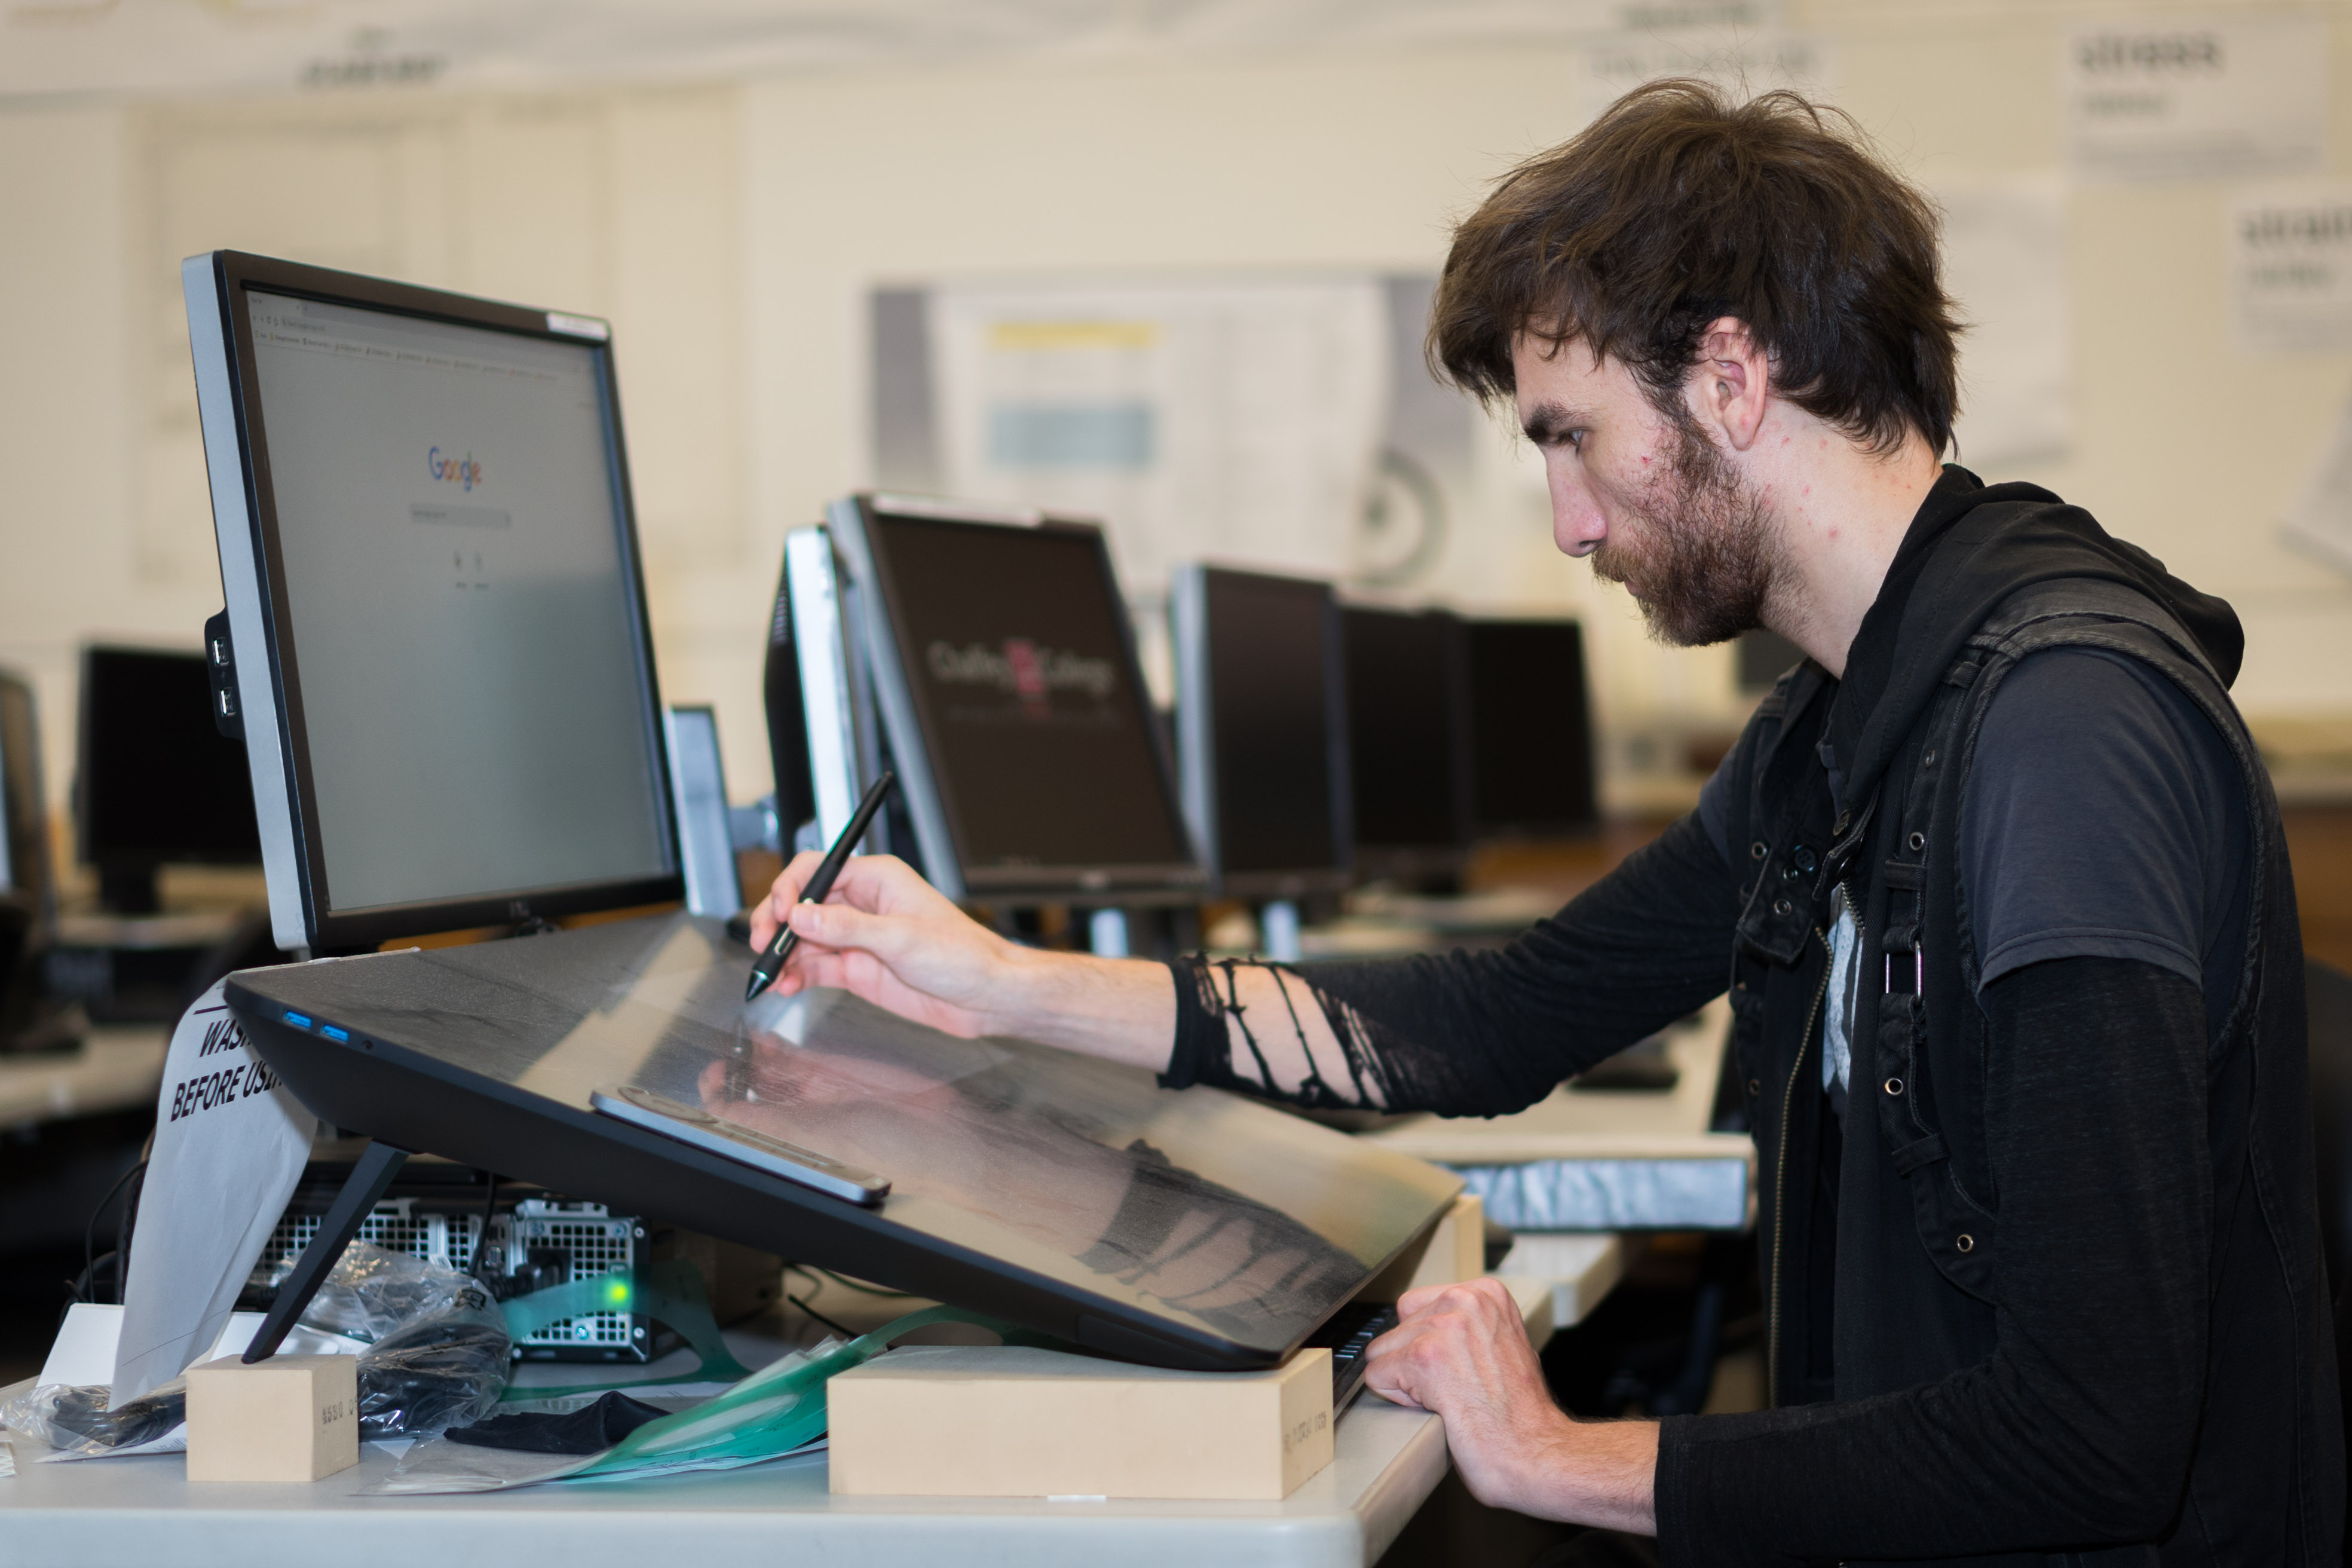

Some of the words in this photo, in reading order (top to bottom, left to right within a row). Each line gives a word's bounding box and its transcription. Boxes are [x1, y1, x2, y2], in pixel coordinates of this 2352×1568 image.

[428, 445, 482, 493] Google
[200, 1018, 251, 1058] WAS
[170, 1065, 246, 1122] BEFORE
[243, 1060, 282, 1098] USI
